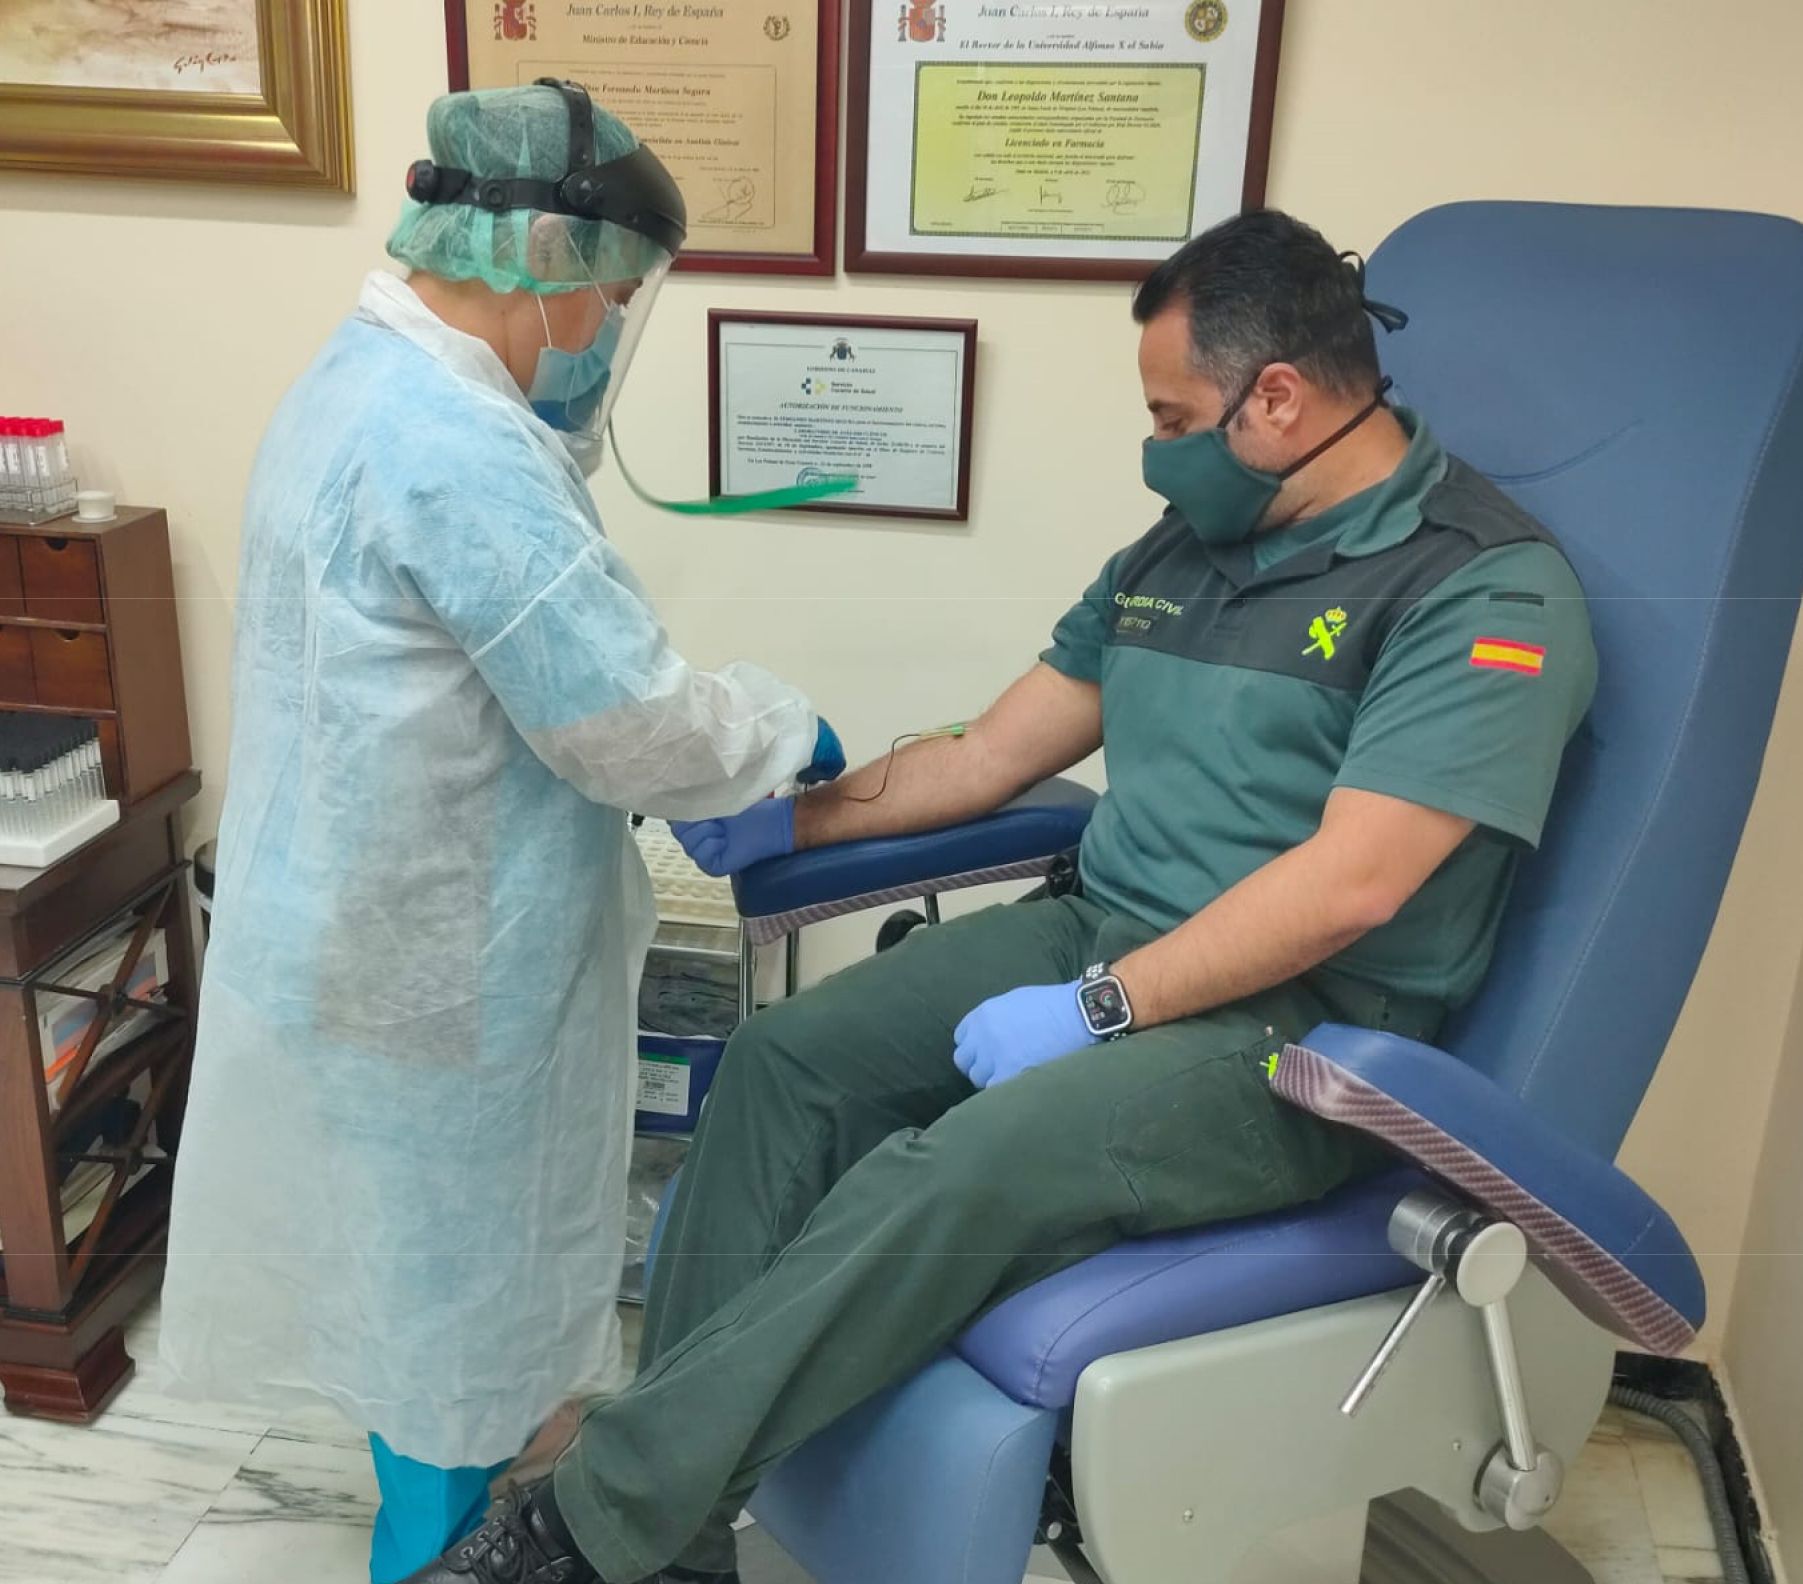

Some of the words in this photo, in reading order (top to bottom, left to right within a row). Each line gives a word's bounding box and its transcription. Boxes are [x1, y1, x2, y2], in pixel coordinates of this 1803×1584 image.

[566, 3, 592, 17] Juan
[595, 4, 631, 17] Carlos
[644, 4, 664, 19] Rey
[667, 5, 680, 17] de
[682, 5, 724, 20] España
[978, 4, 1007, 18] Juan
[1062, 6, 1083, 20] Rey
[1087, 6, 1100, 18] de
[582, 34, 616, 45] Ministro
[618, 35, 627, 45] de
[678, 35, 709, 46] Ciencia
[1003, 39, 1014, 50] de
[1028, 39, 1080, 50] Universidad
[977, 89, 998, 101] Don
[1001, 90, 1047, 104] Leopoldo
[1050, 90, 1095, 102] Martínez
[1099, 91, 1139, 103] Santana
[1005, 138, 1050, 148] Licenciado
[1052, 140, 1062, 148] en
[1065, 138, 1105, 148] Farmacia
[1114, 592, 1154, 609] GRDIA
